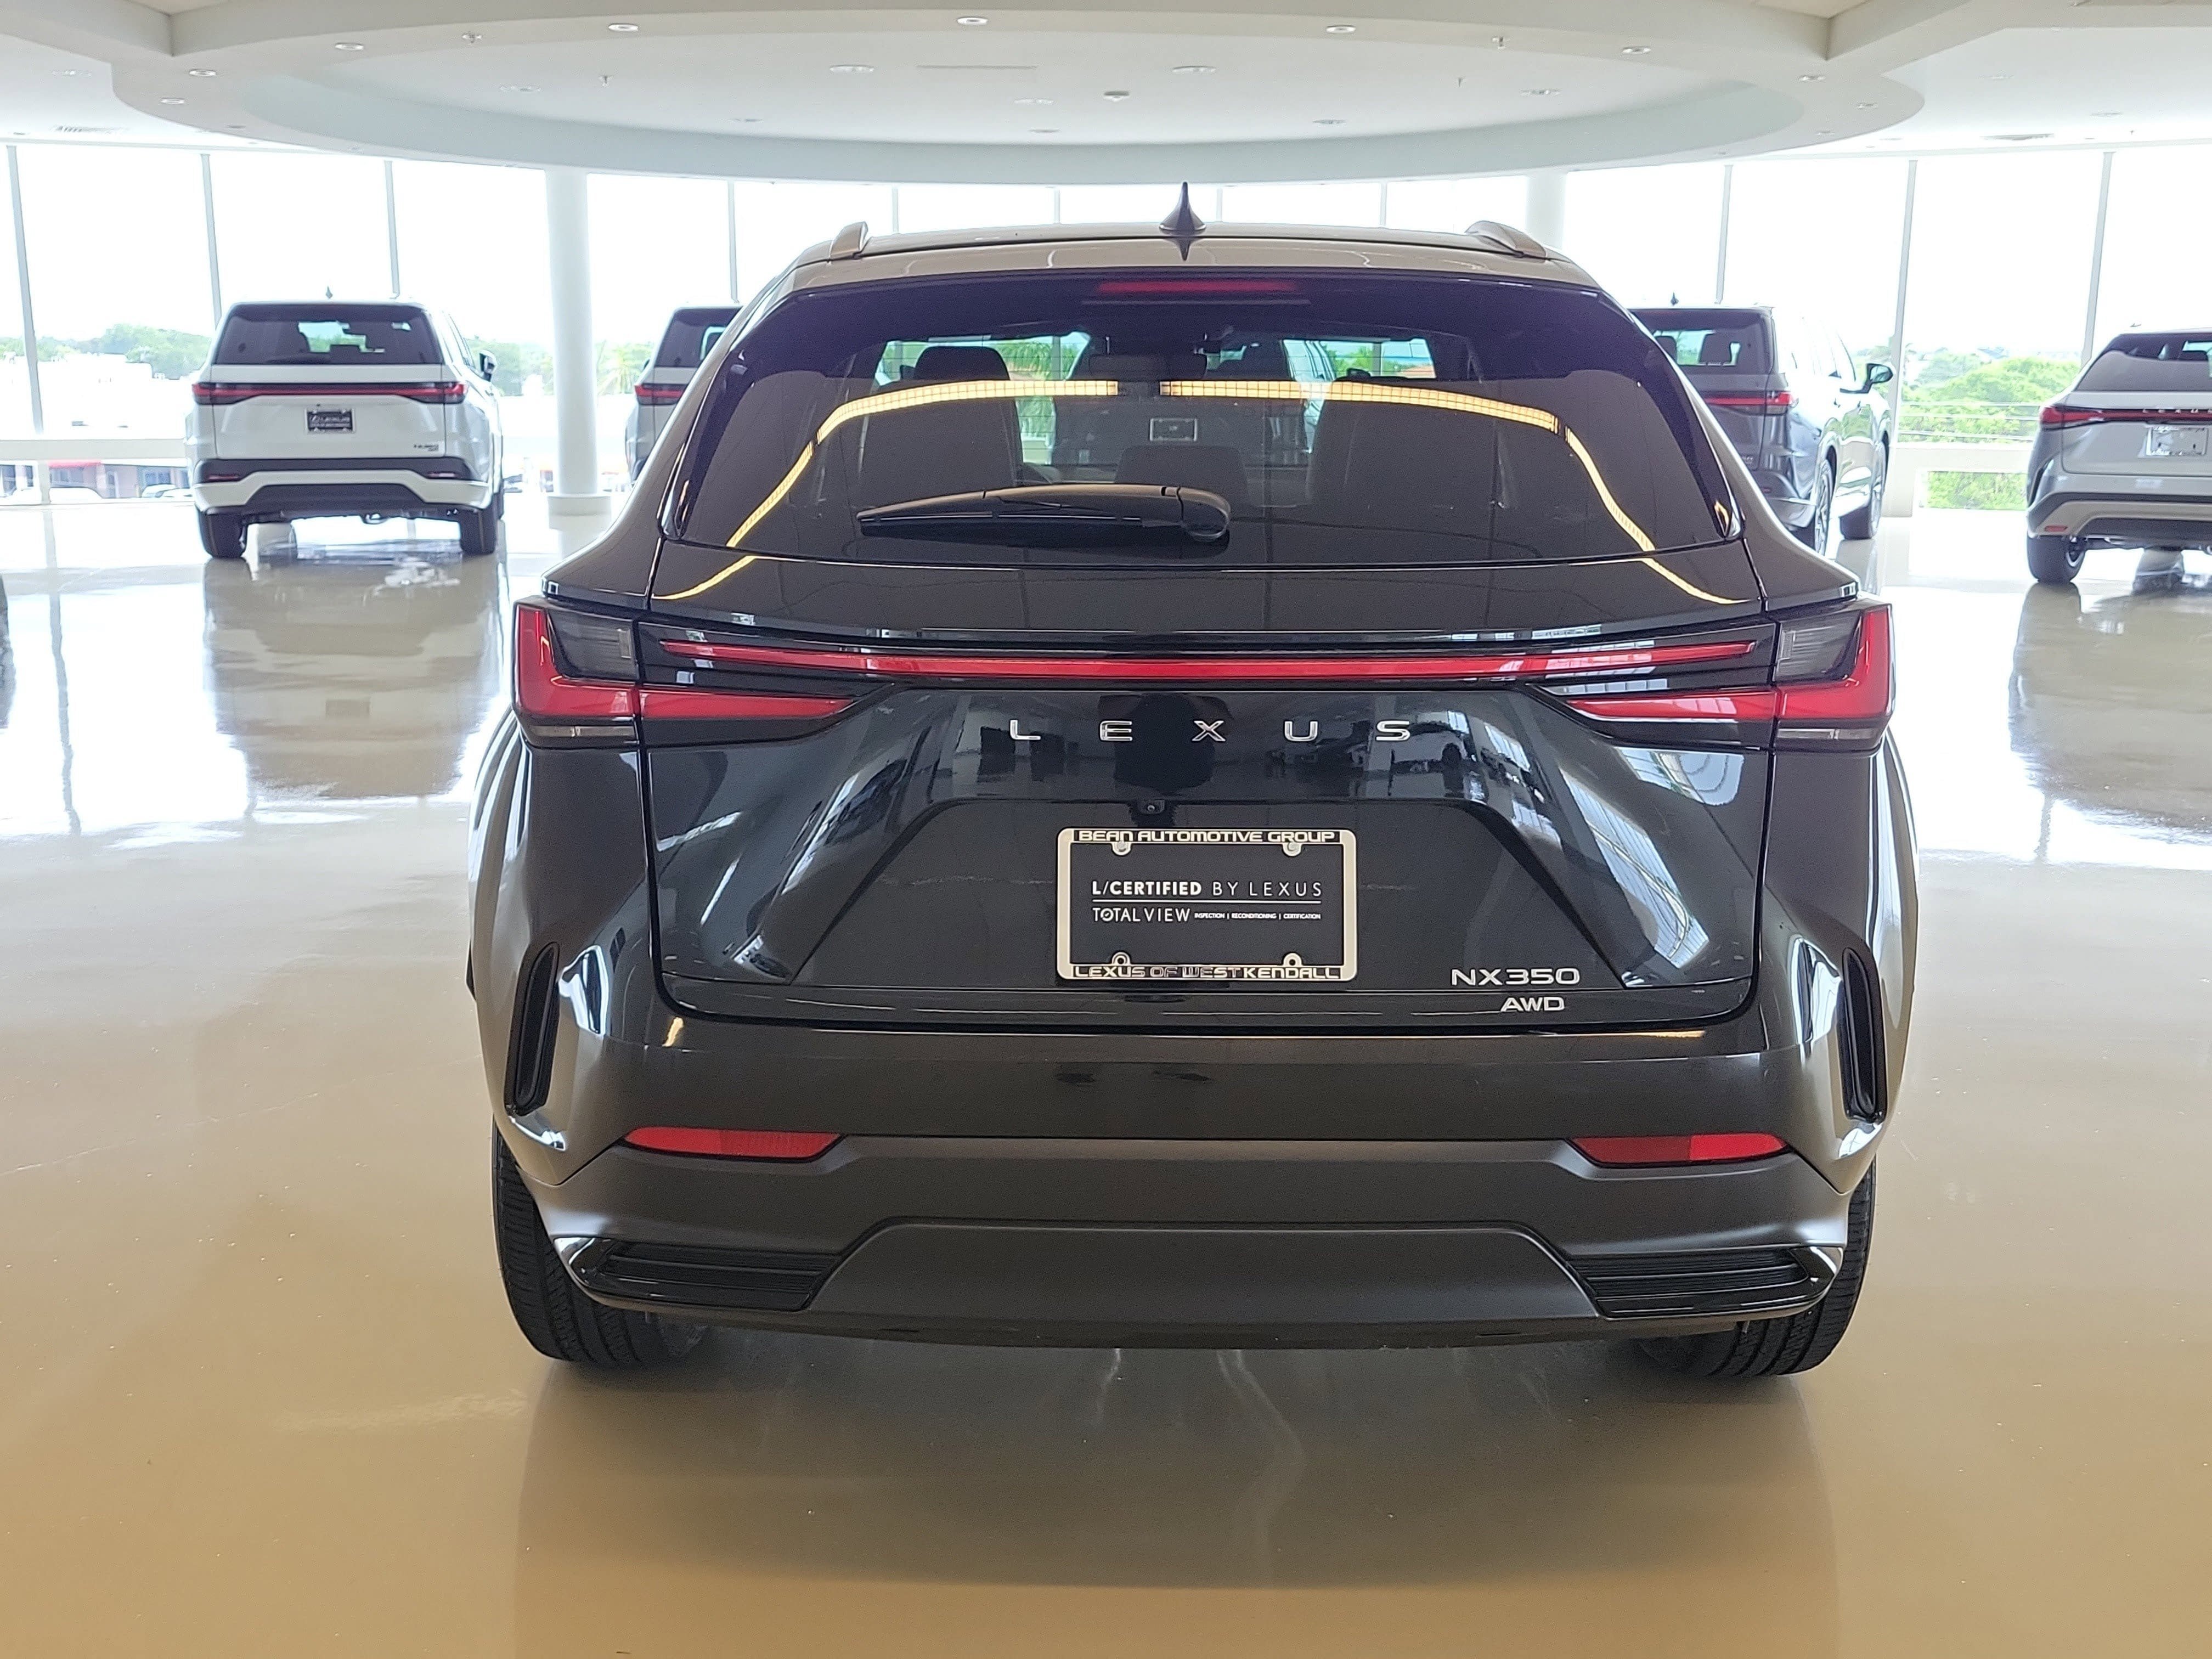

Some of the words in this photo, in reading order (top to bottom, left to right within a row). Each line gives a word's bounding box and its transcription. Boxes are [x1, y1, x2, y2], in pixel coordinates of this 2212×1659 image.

[1009, 719, 1410, 742] LEXUS
[1079, 831, 1133, 842] BEAN
[1137, 831, 1263, 842] AUTOMOTIVE
[1268, 831, 1335, 842] GROUP
[1092, 881, 1202, 895] L/CERTIFIED
[1212, 881, 1238, 896] BY
[1249, 881, 1322, 896] LEXUS
[1075, 966, 1146, 978] LEXUS
[1149, 966, 1178, 978] OF
[1182, 966, 1242, 978] WEST
[1244, 967, 1339, 979] KENDALL
[1451, 968, 1581, 986] NX350
[1500, 996, 1565, 1012] AWD
